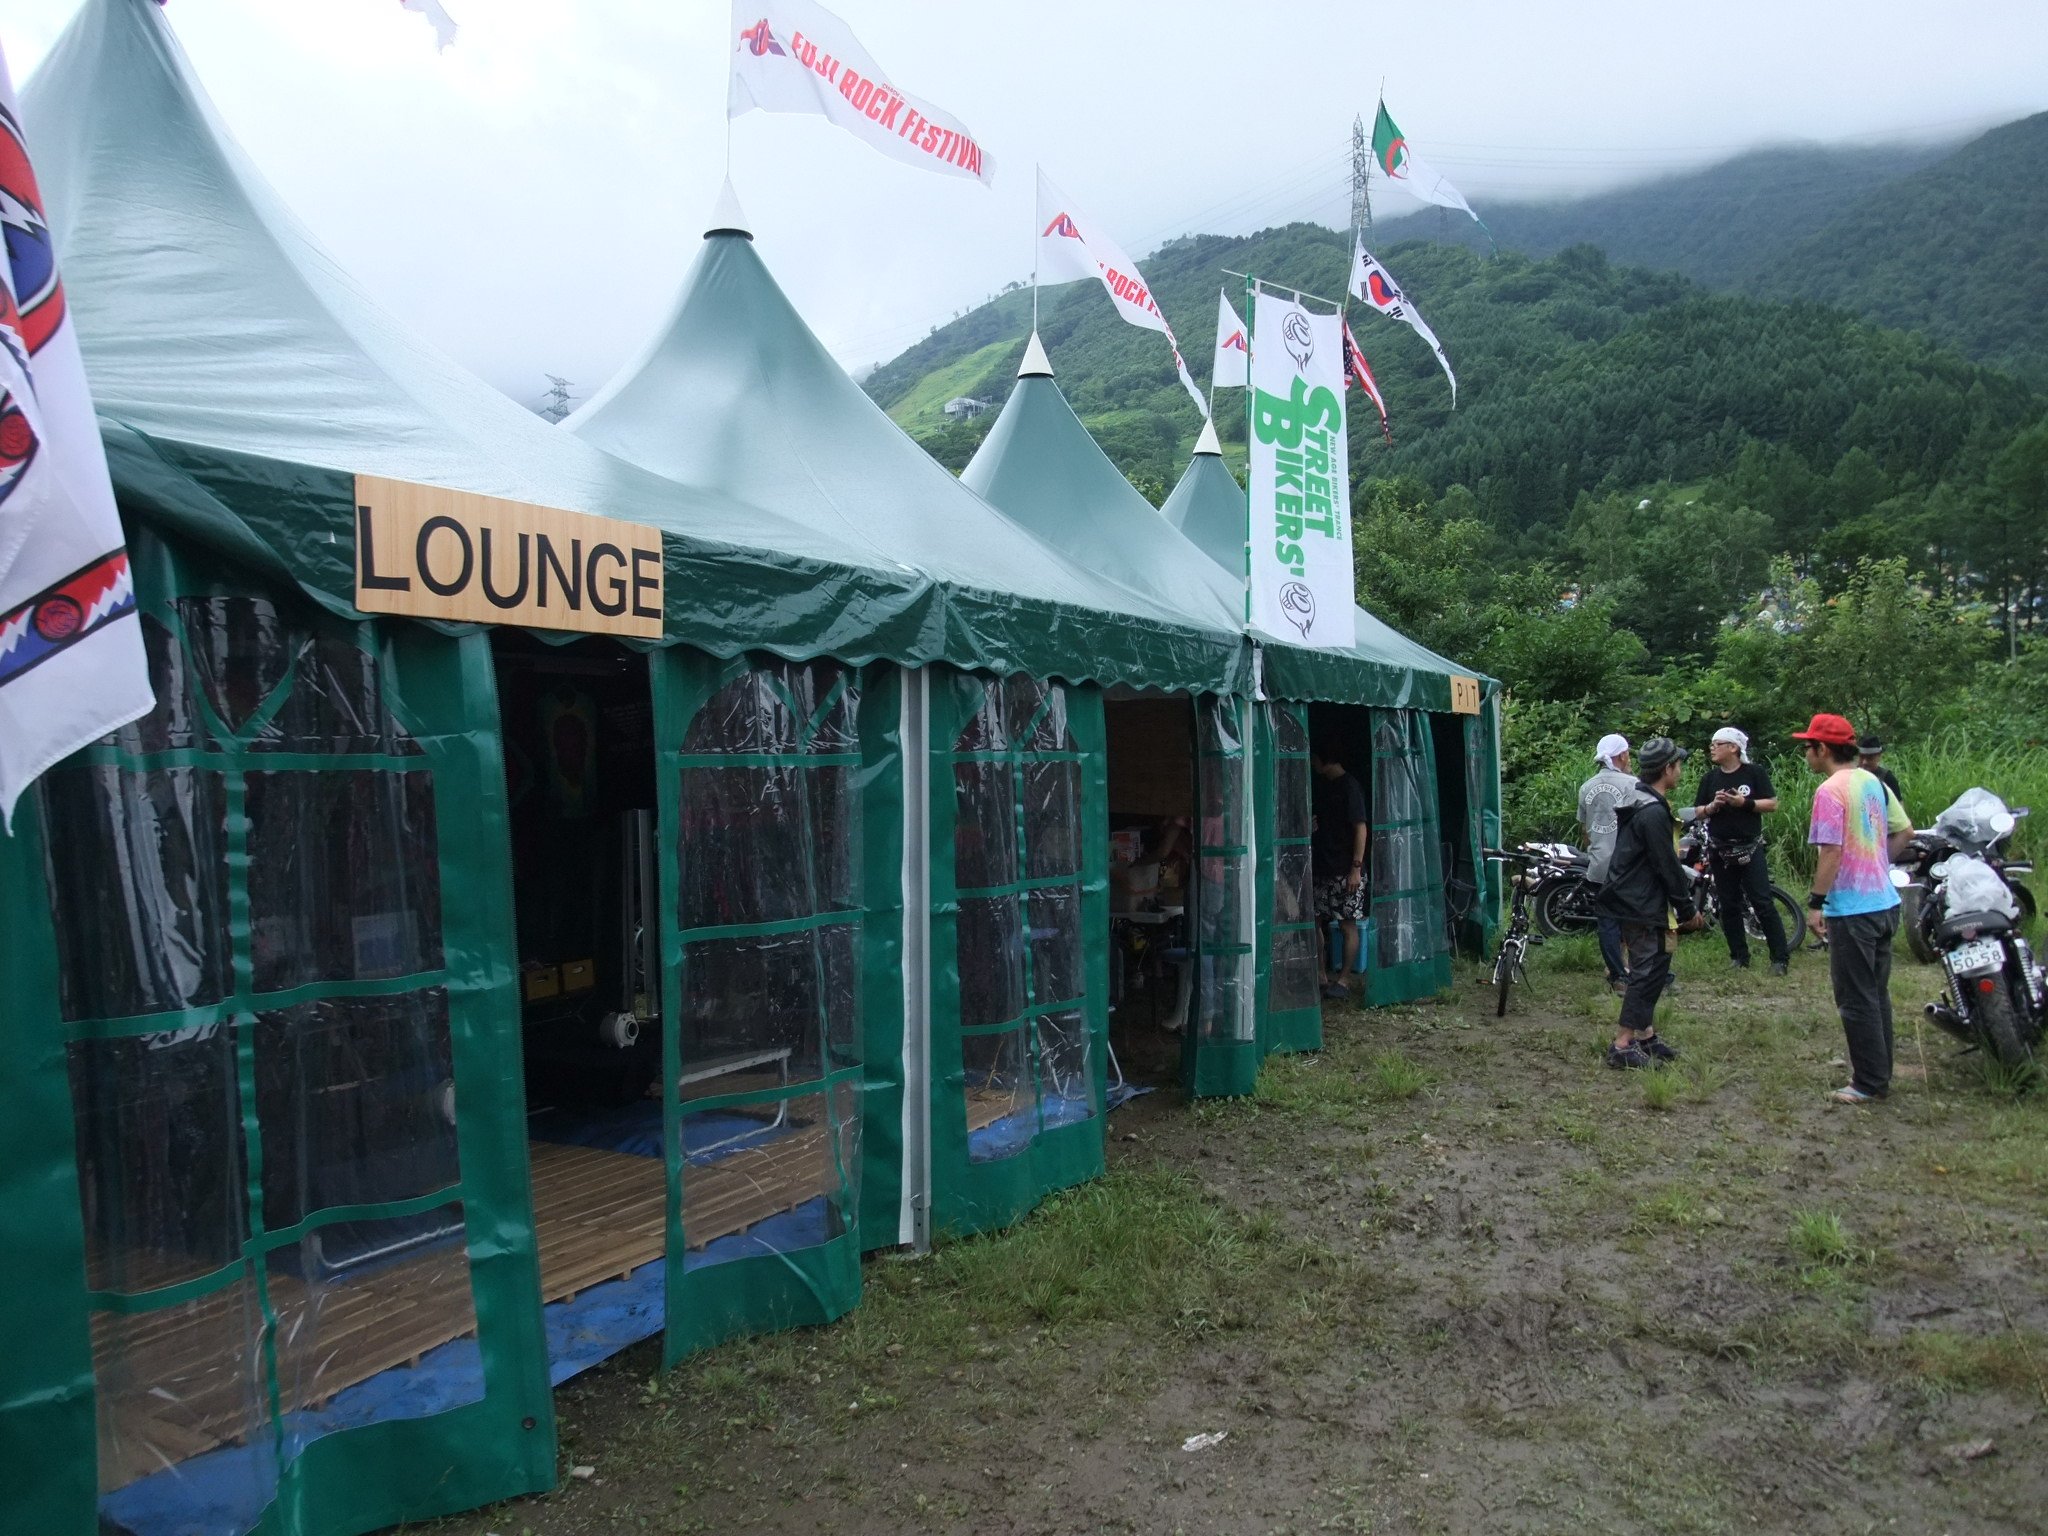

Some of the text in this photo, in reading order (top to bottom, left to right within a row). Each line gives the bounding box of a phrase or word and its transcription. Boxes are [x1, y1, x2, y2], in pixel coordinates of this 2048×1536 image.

[791, 31, 840, 85] FUJI
[839, 68, 905, 131] ROCK
[1106, 267, 1148, 308] ROCK
[1291, 374, 1342, 539] STREET
[1329, 435, 1337, 455] NEW
[1330, 457, 1338, 474] AGE
[1254, 386, 1305, 577] BIKERS'
[358, 505, 662, 620] LOUNGE
[1457, 682, 1477, 708] PIT
